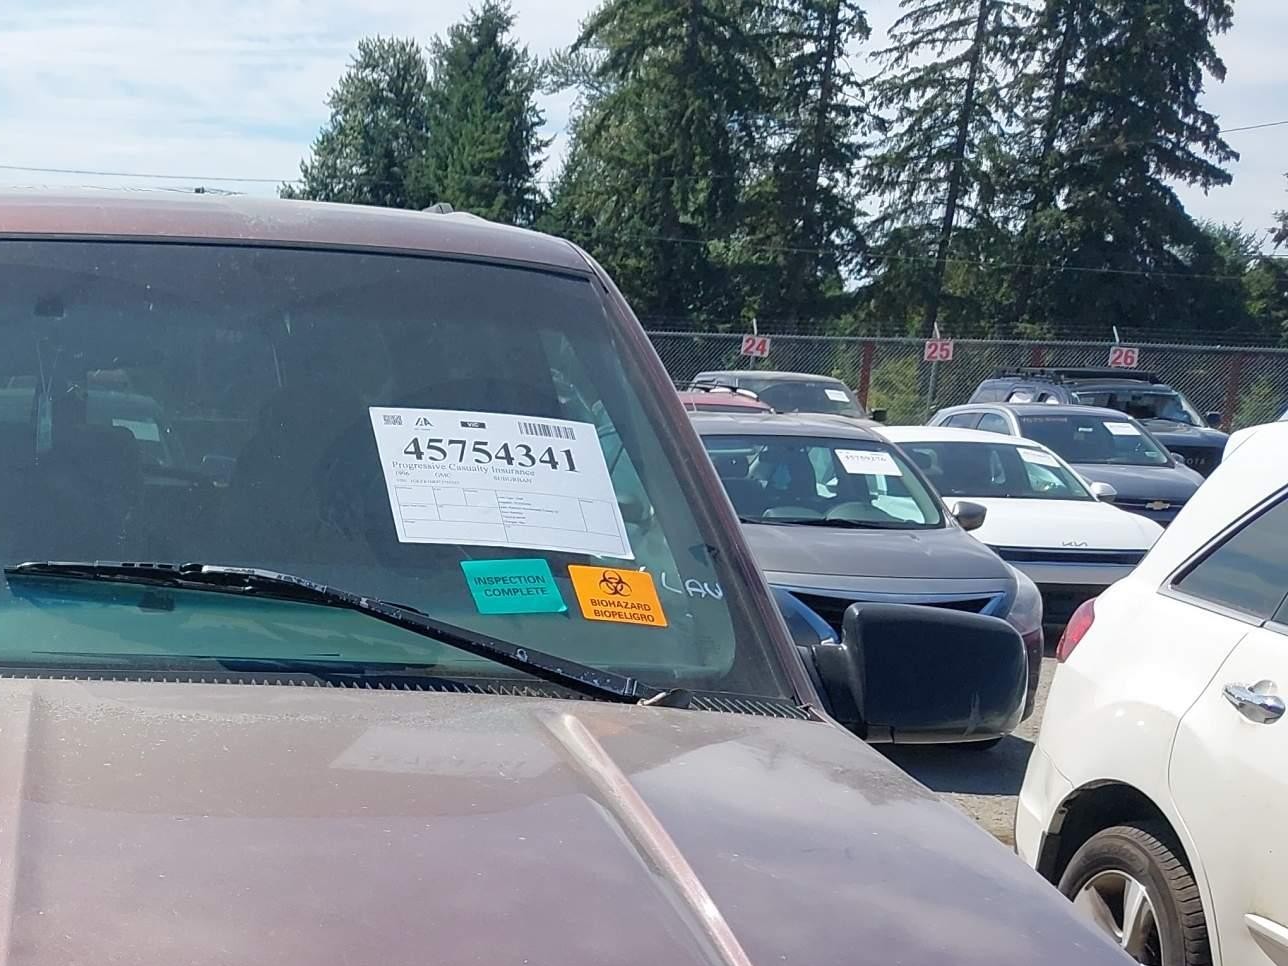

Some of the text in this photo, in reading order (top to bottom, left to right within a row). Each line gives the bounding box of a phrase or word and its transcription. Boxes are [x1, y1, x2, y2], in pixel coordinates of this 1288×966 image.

[743, 336, 767, 354] 24
[926, 342, 951, 360] 25
[1112, 348, 1135, 365] 26
[403, 437, 581, 473] 45754341
[392, 461, 535, 477] Progressive Casualty Insurance
[473, 575, 546, 586] INSPECTION
[484, 586, 549, 597] COMPLETE
[590, 598, 652, 612] BIOHAZARD
[593, 608, 655, 623] BIOPELIGRO
